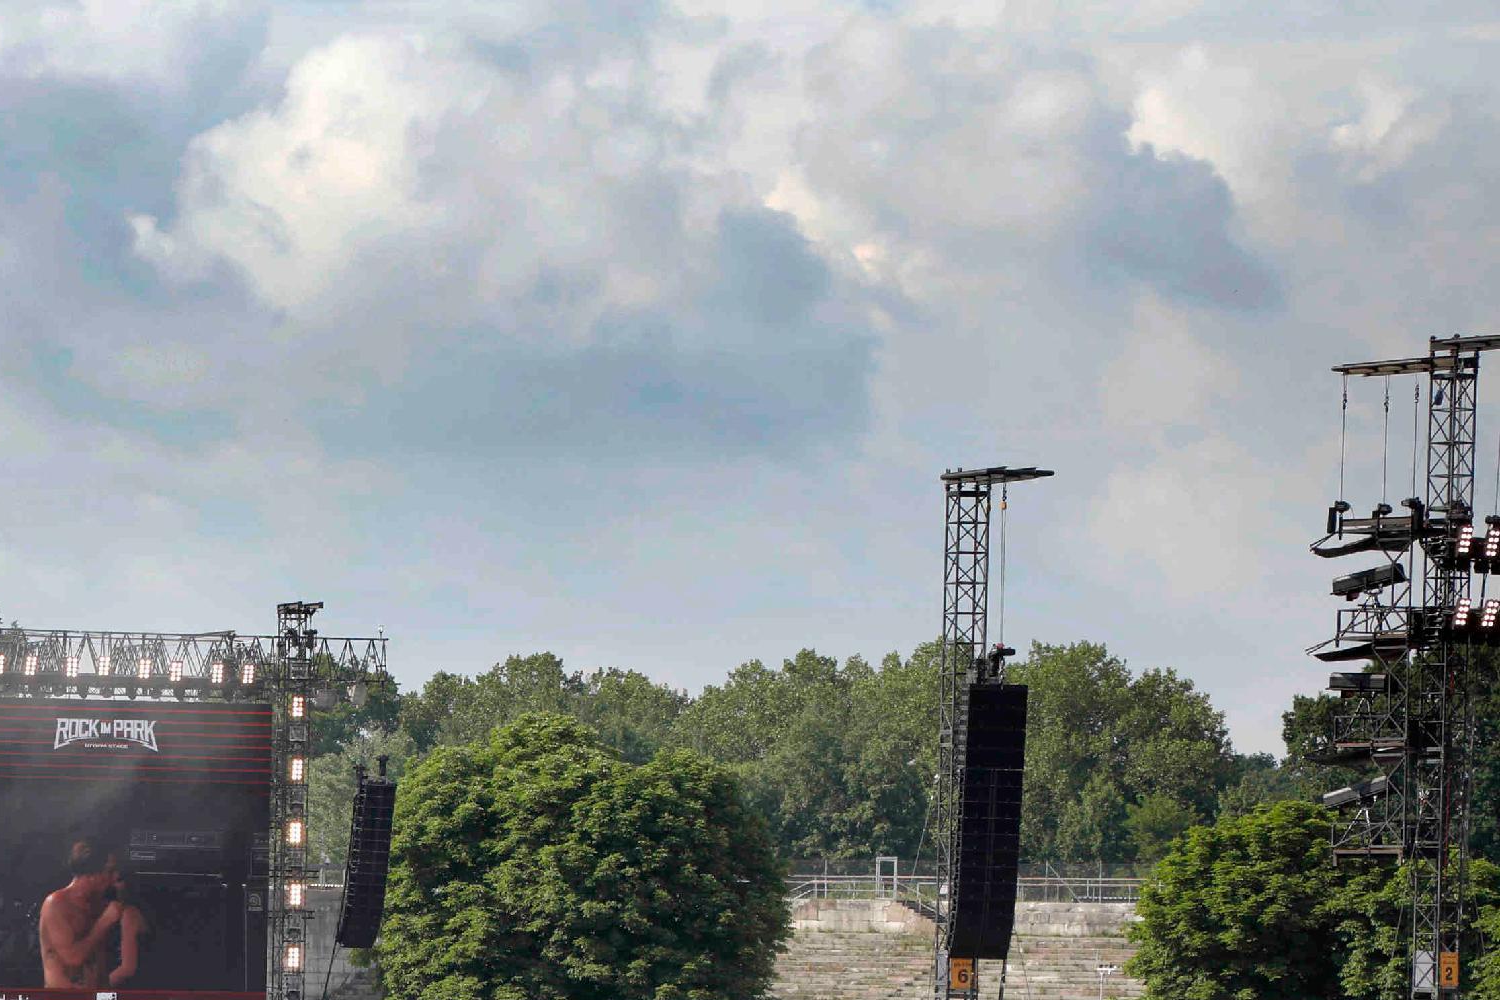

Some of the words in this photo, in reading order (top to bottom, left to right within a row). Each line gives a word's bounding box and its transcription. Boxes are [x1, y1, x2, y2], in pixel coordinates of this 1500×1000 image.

[54, 718, 100, 750] ROCK
[113, 719, 159, 752] PARK
[958, 969, 969, 984] 6
[1445, 966, 1453, 981] 2
